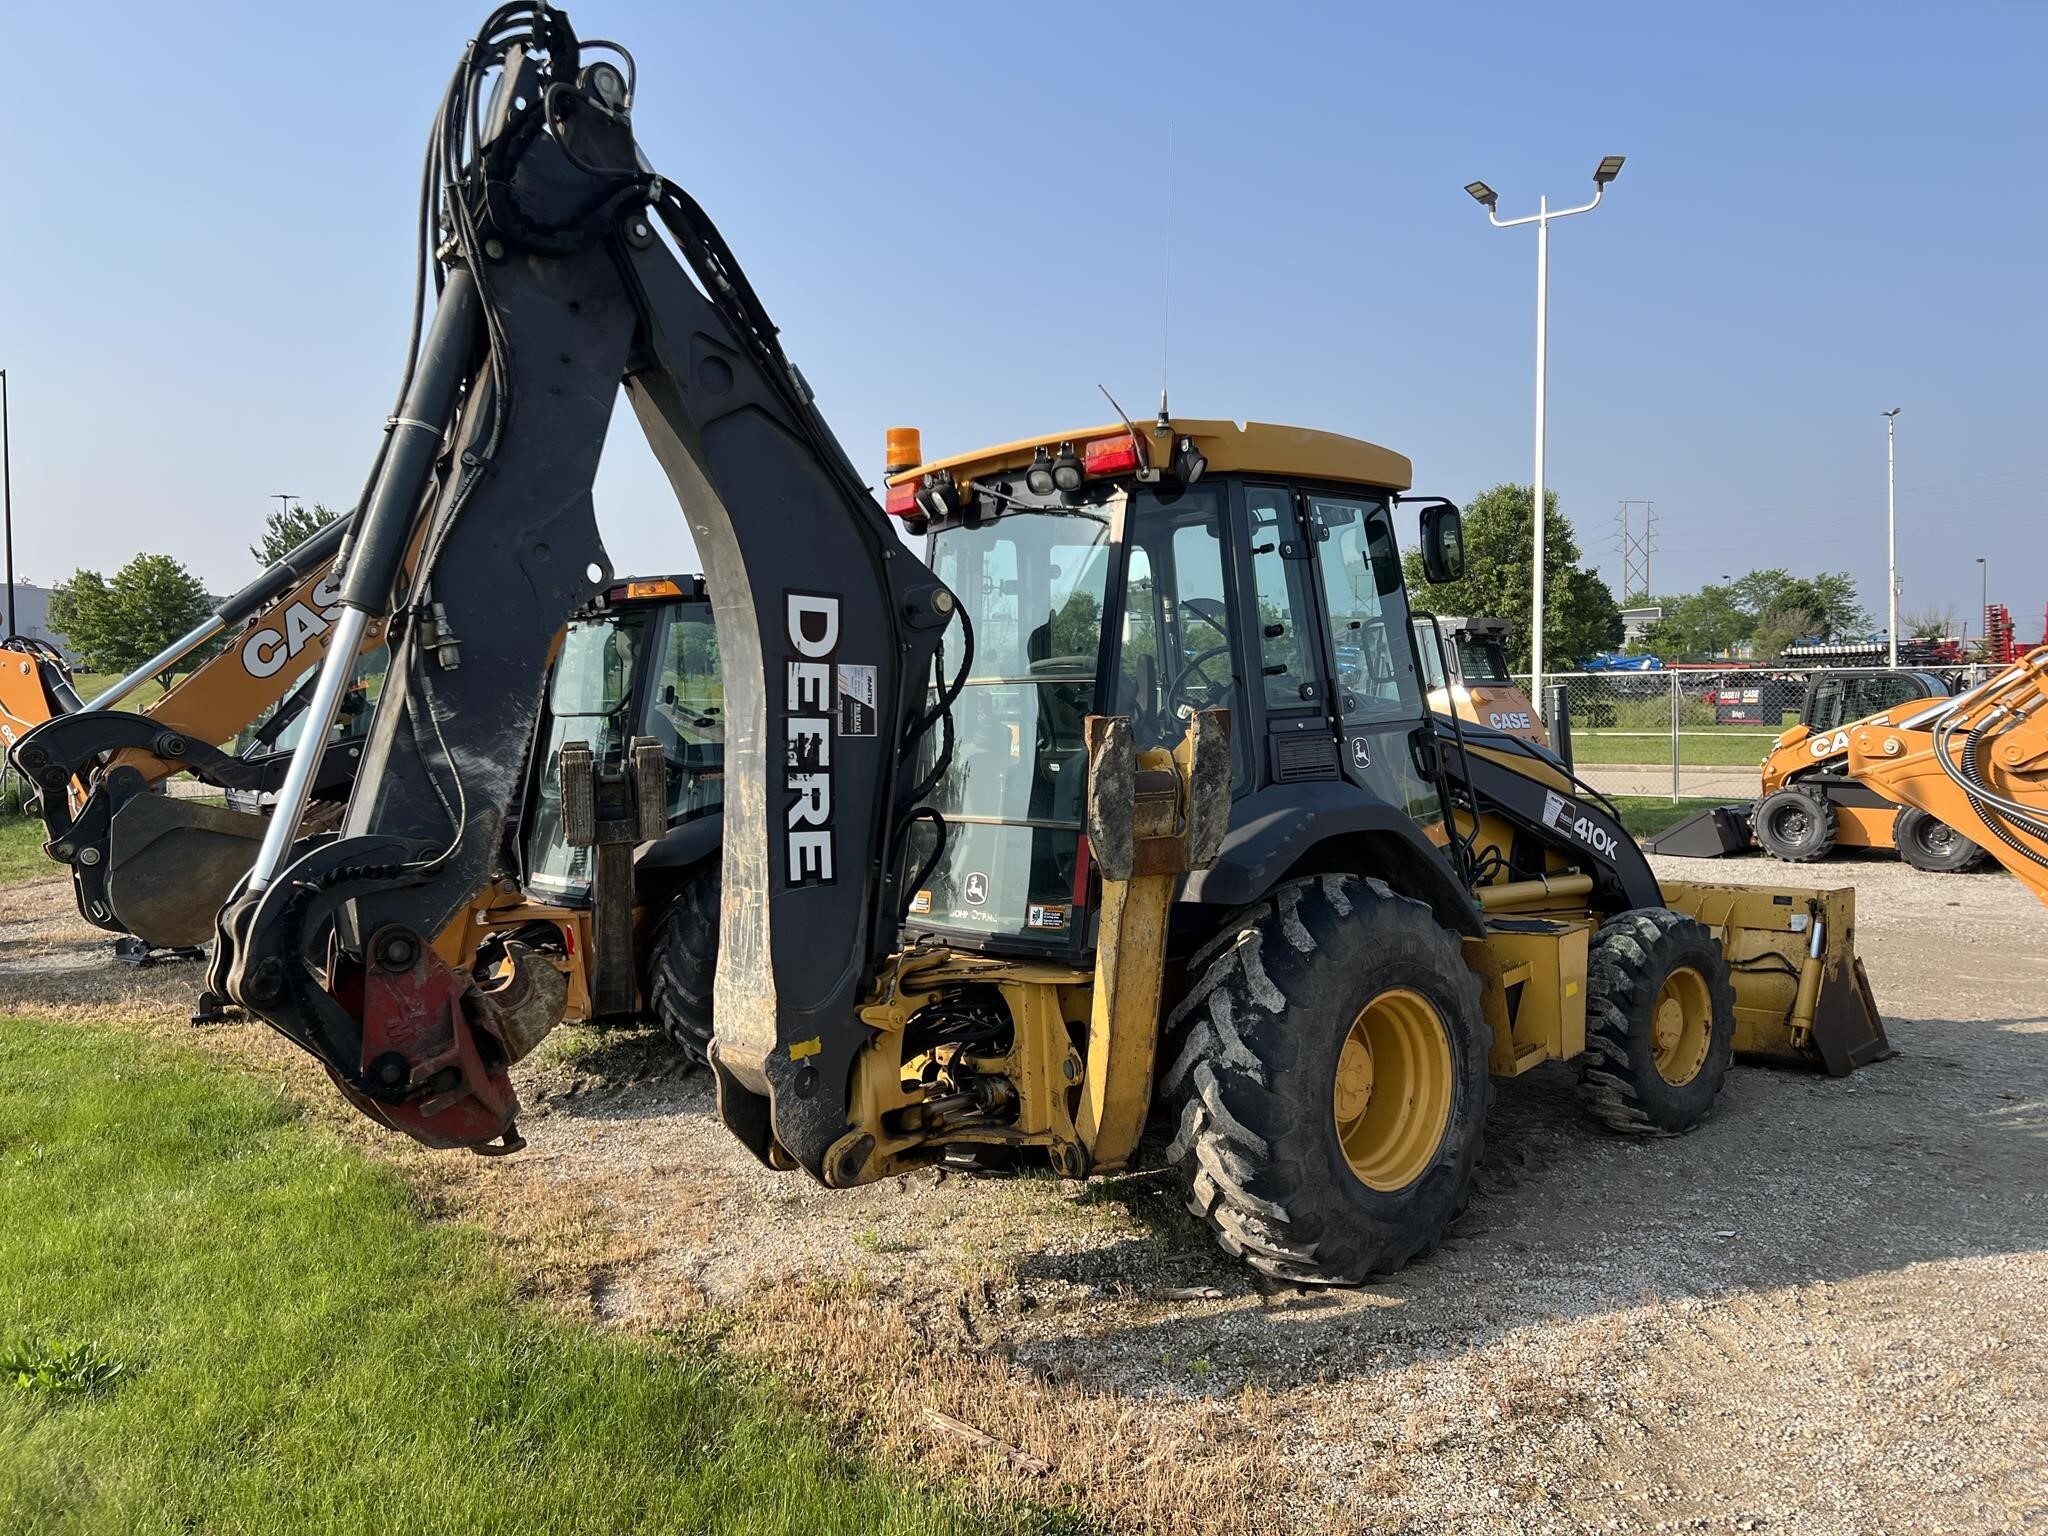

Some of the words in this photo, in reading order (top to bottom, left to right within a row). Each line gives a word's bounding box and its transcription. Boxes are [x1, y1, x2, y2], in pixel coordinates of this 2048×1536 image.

[242, 576, 342, 678] CAS
[788, 594, 839, 881] DEERE
[1489, 712, 1531, 730] CASE
[1573, 816, 1619, 861] 410K
